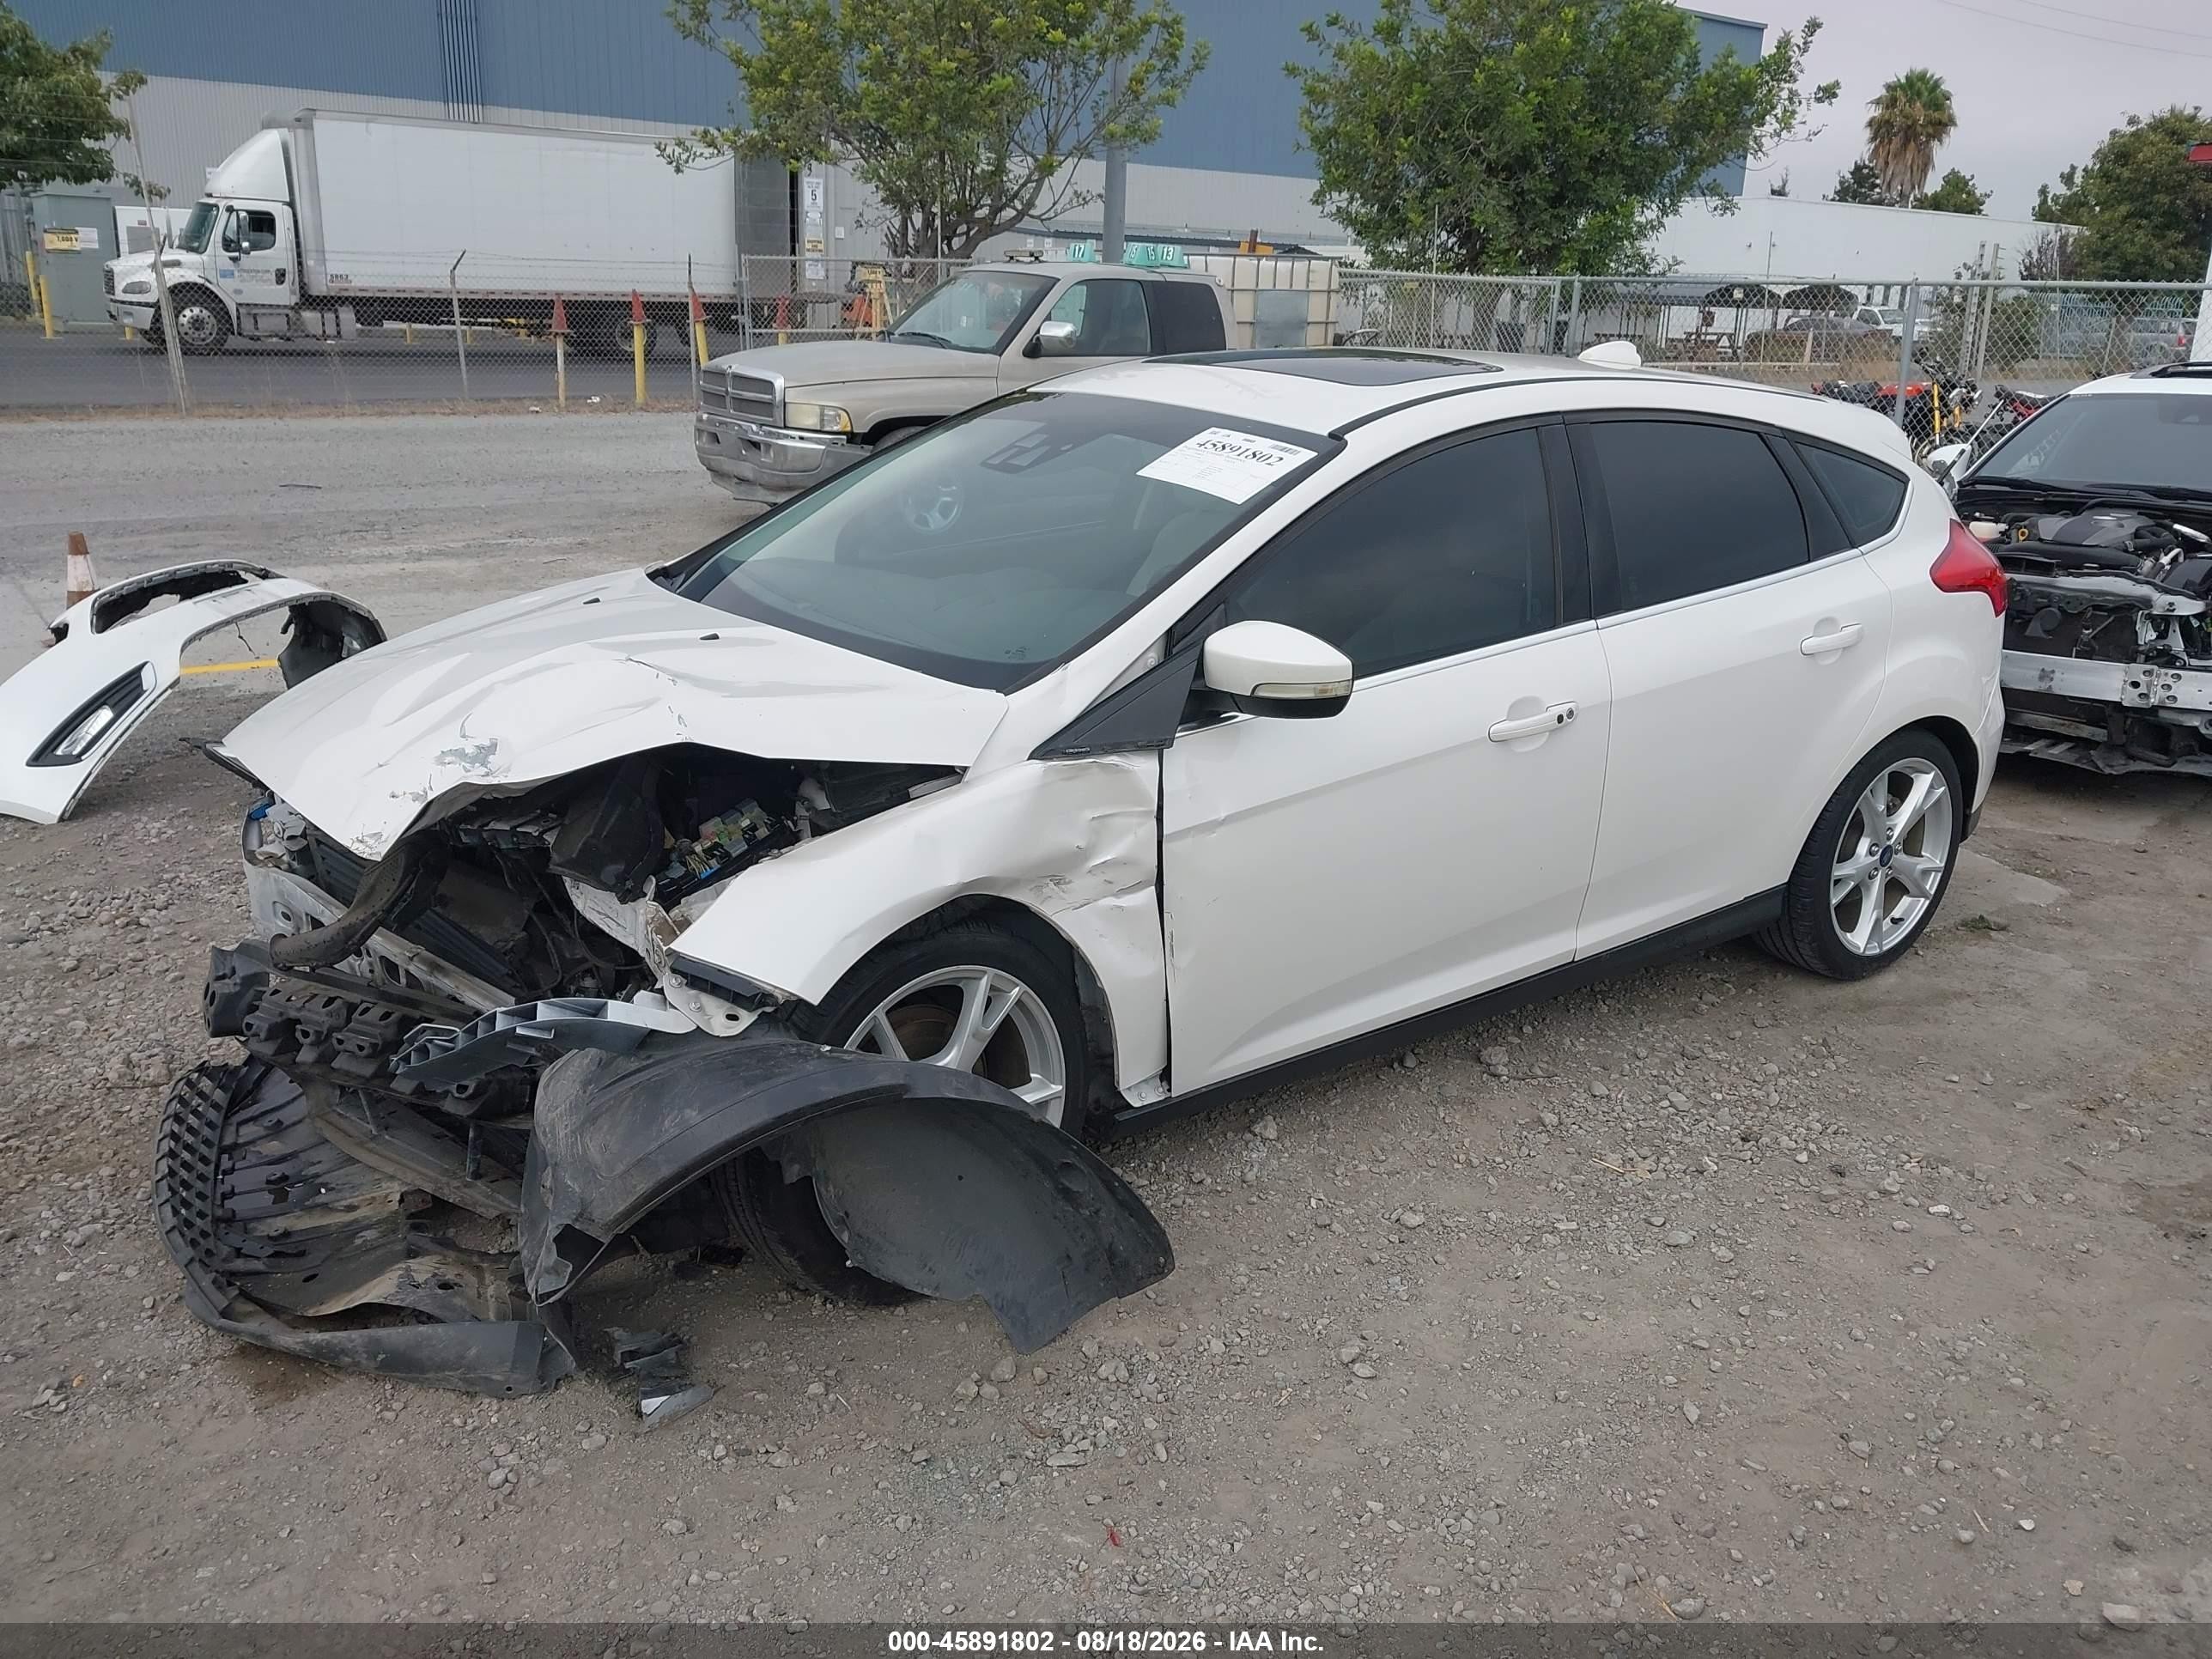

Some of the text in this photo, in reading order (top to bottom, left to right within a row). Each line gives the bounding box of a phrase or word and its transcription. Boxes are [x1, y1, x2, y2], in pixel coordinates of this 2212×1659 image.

[811, 189, 817, 201] 5
[1073, 244, 1085, 258] 17
[1147, 246, 1155, 260] 15
[1162, 246, 1175, 260] 13
[1196, 439, 1285, 466] 45891802
